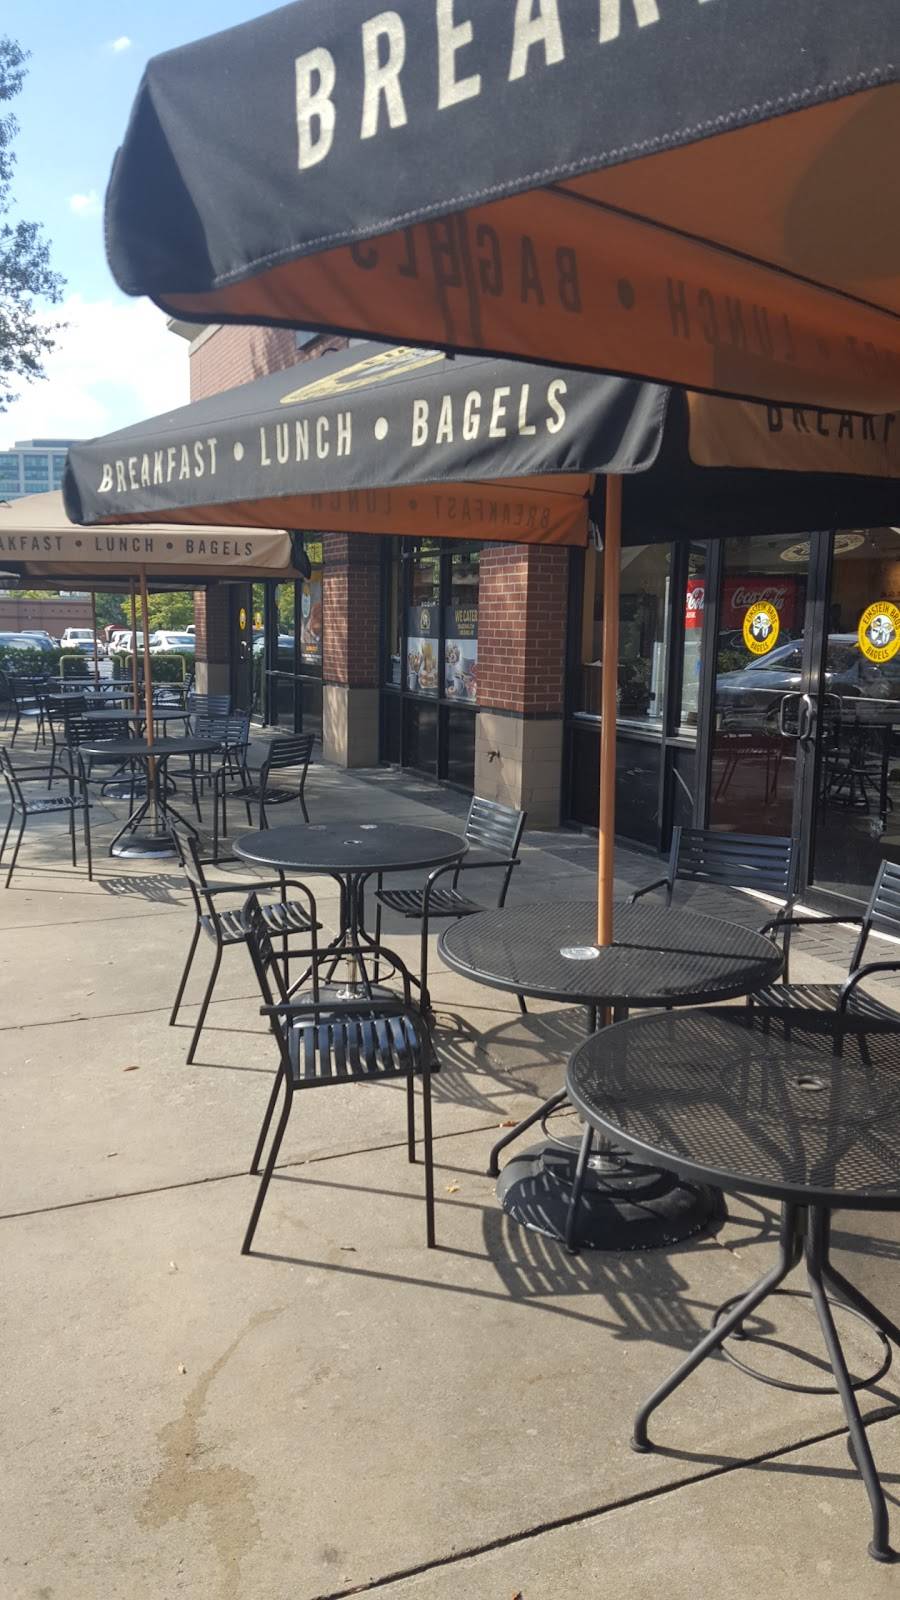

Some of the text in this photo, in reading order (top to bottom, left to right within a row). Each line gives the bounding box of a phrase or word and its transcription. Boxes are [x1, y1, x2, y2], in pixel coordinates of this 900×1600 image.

[97, 379, 568, 493] BREAKFAST LUNCH BAGELS
[95, 537, 154, 553] LUNCH
[186, 539, 253, 556] BAGELS
[863, 603, 890, 625] EINSTEIN
[865, 646, 890, 660] BAGELS
